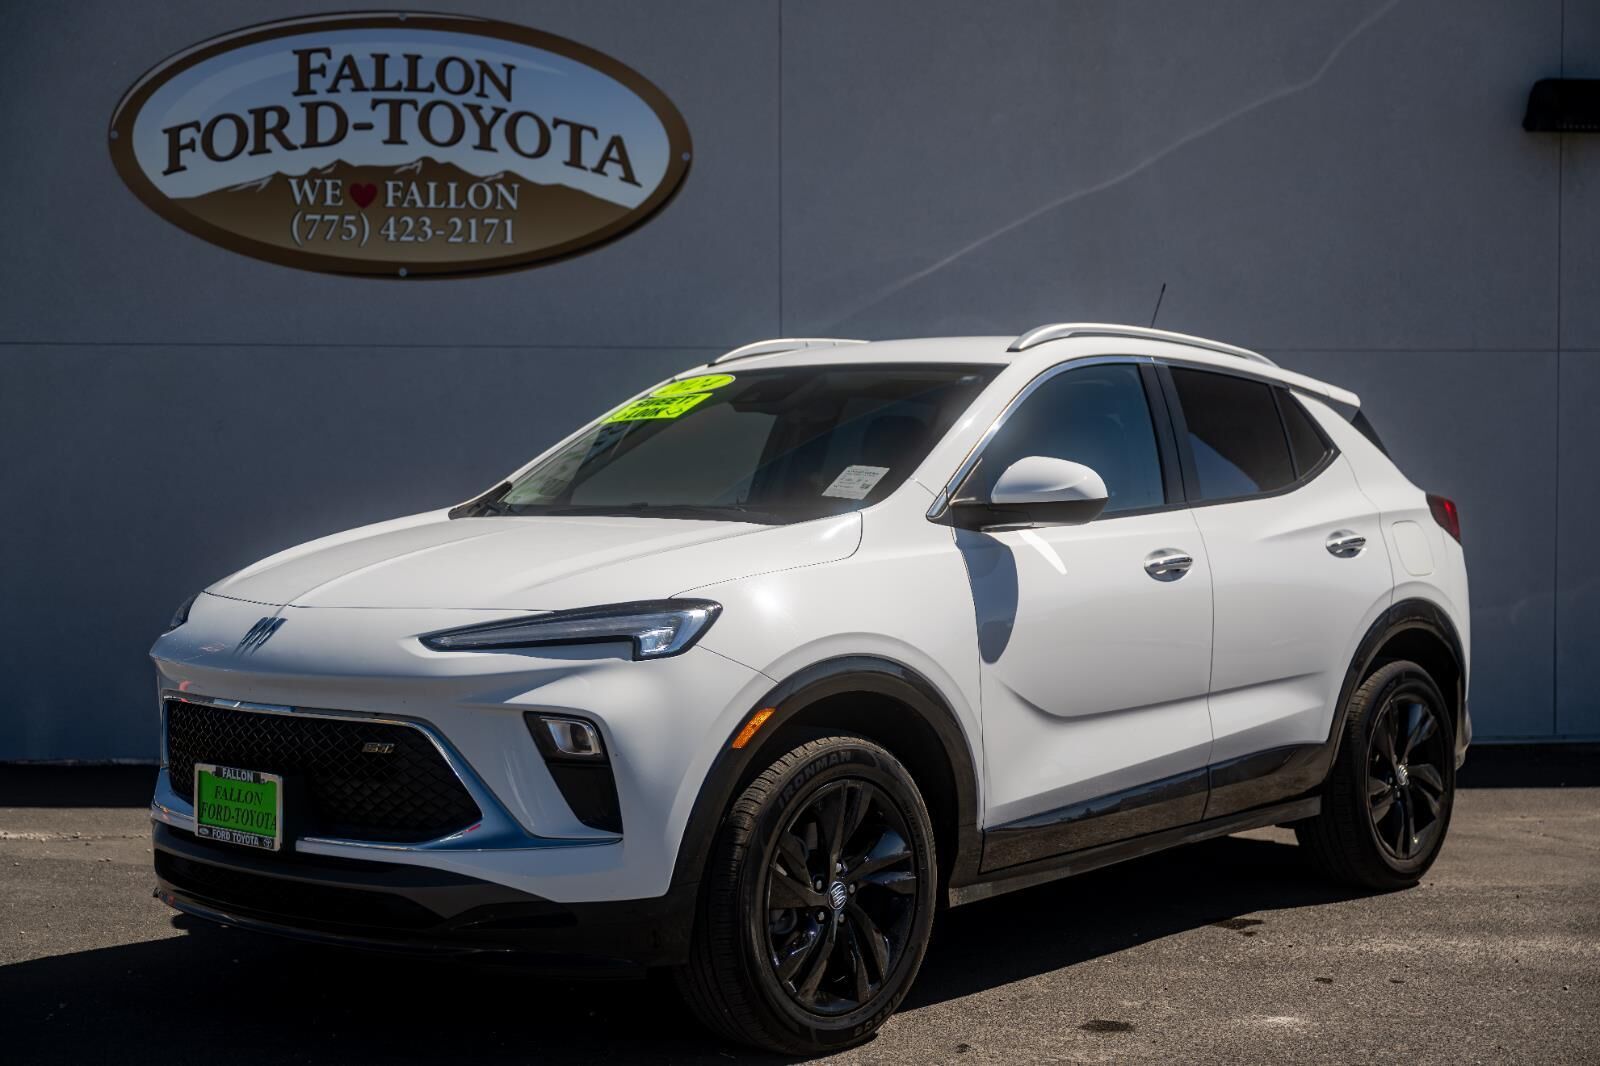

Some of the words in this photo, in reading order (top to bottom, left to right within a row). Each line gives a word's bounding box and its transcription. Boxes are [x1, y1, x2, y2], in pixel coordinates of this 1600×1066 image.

[292, 46, 516, 102] FALLON
[162, 98, 643, 189] FORD-TOYOTA
[288, 179, 343, 209] WE
[385, 181, 519, 211] FALLON
[290, 212, 372, 247] (775)
[380, 216, 516, 245] 423-2171
[222, 767, 254, 782] FALLON
[777, 751, 852, 810] IRONMAN
[214, 785, 264, 806] FALLON
[212, 829, 231, 840] FORD
[232, 832, 260, 846] TOYOTA
